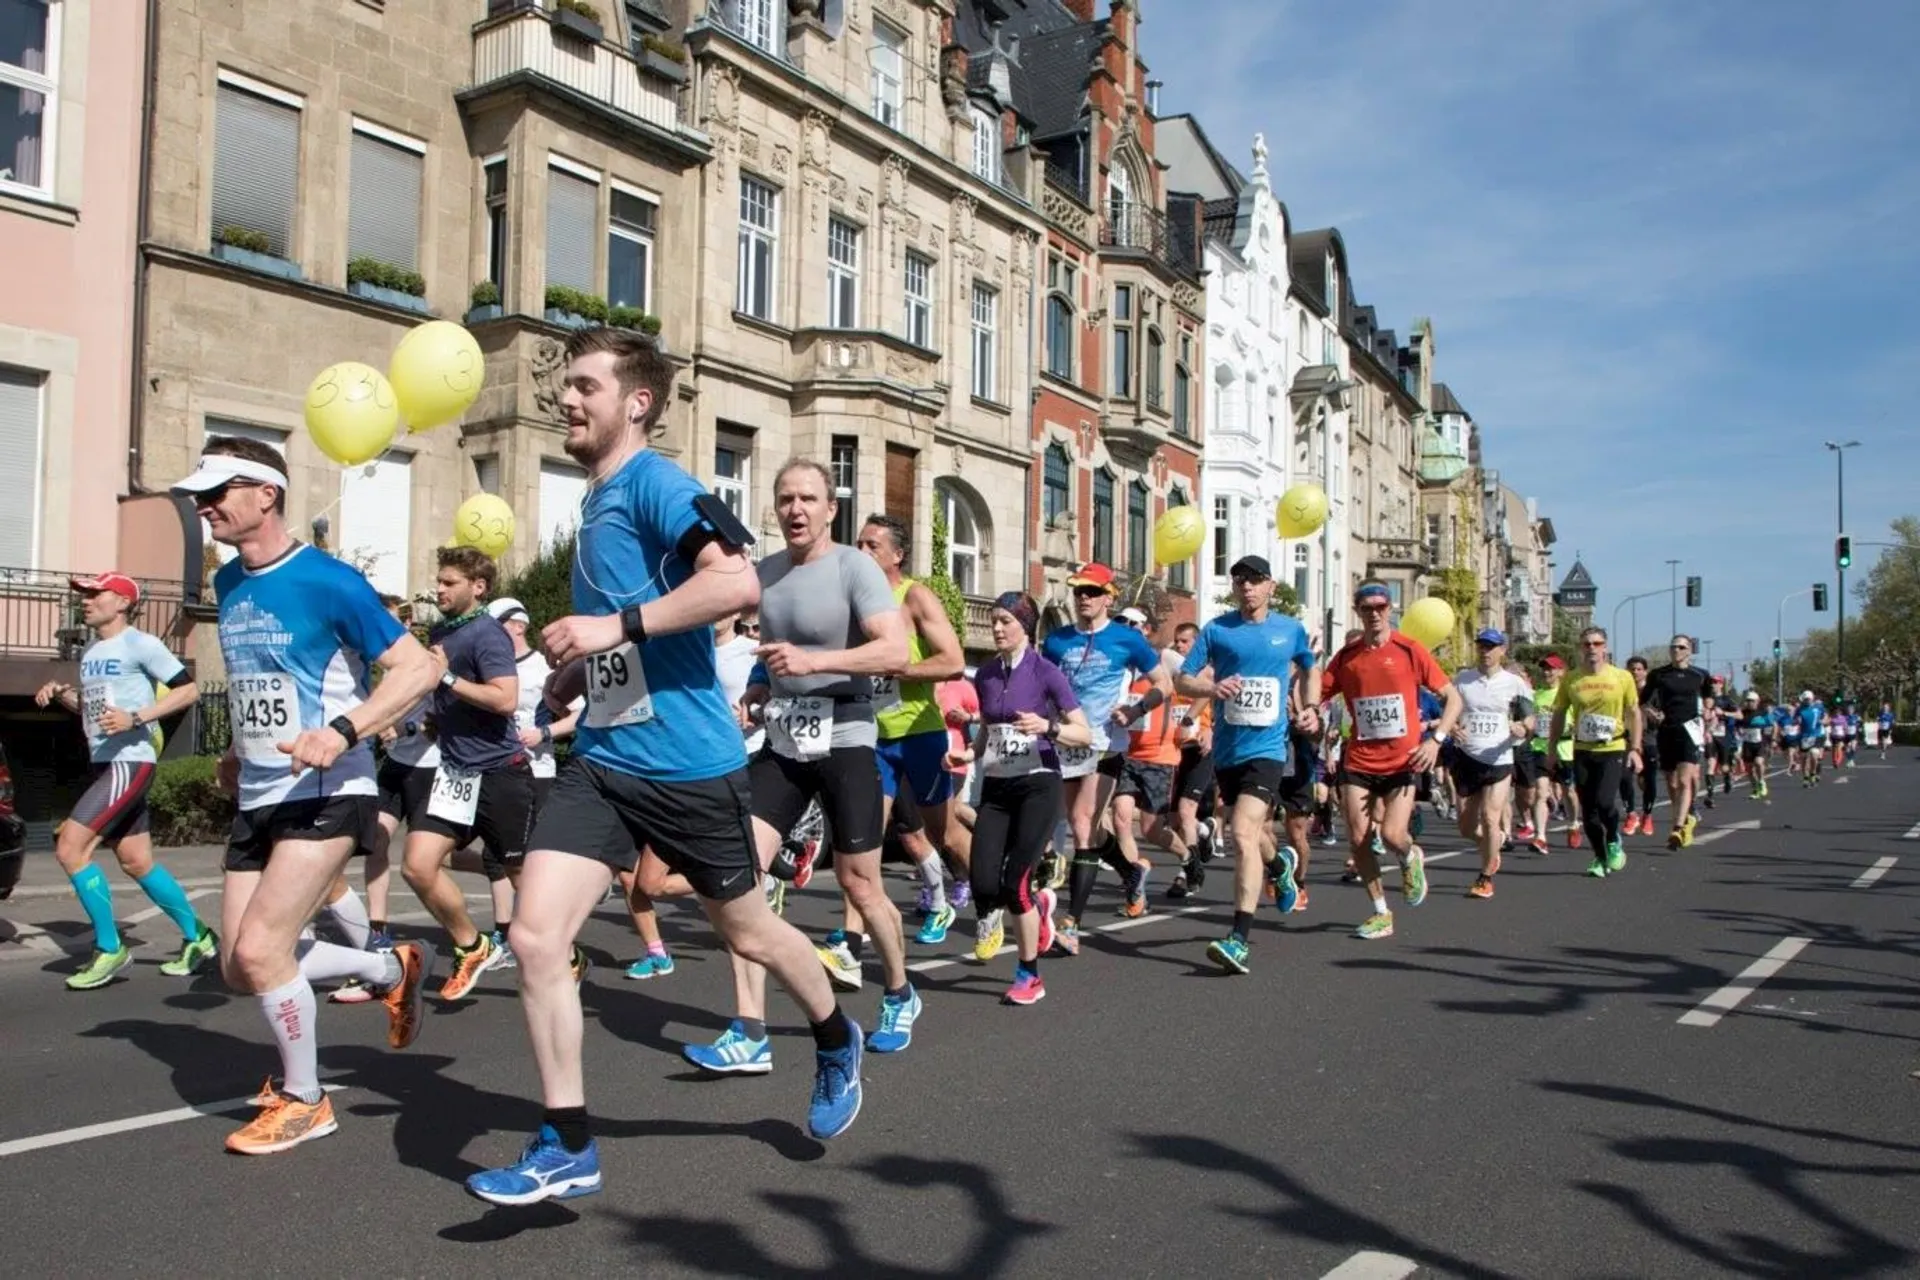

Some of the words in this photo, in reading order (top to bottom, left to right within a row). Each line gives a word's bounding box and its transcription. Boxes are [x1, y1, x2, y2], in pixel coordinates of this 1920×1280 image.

[1234, 690, 1273, 708] 4278
[236, 697, 289, 728] 3435
[1364, 707, 1399, 724] 3434
[775, 714, 821, 739] 1128
[1470, 721, 1499, 734] 3137
